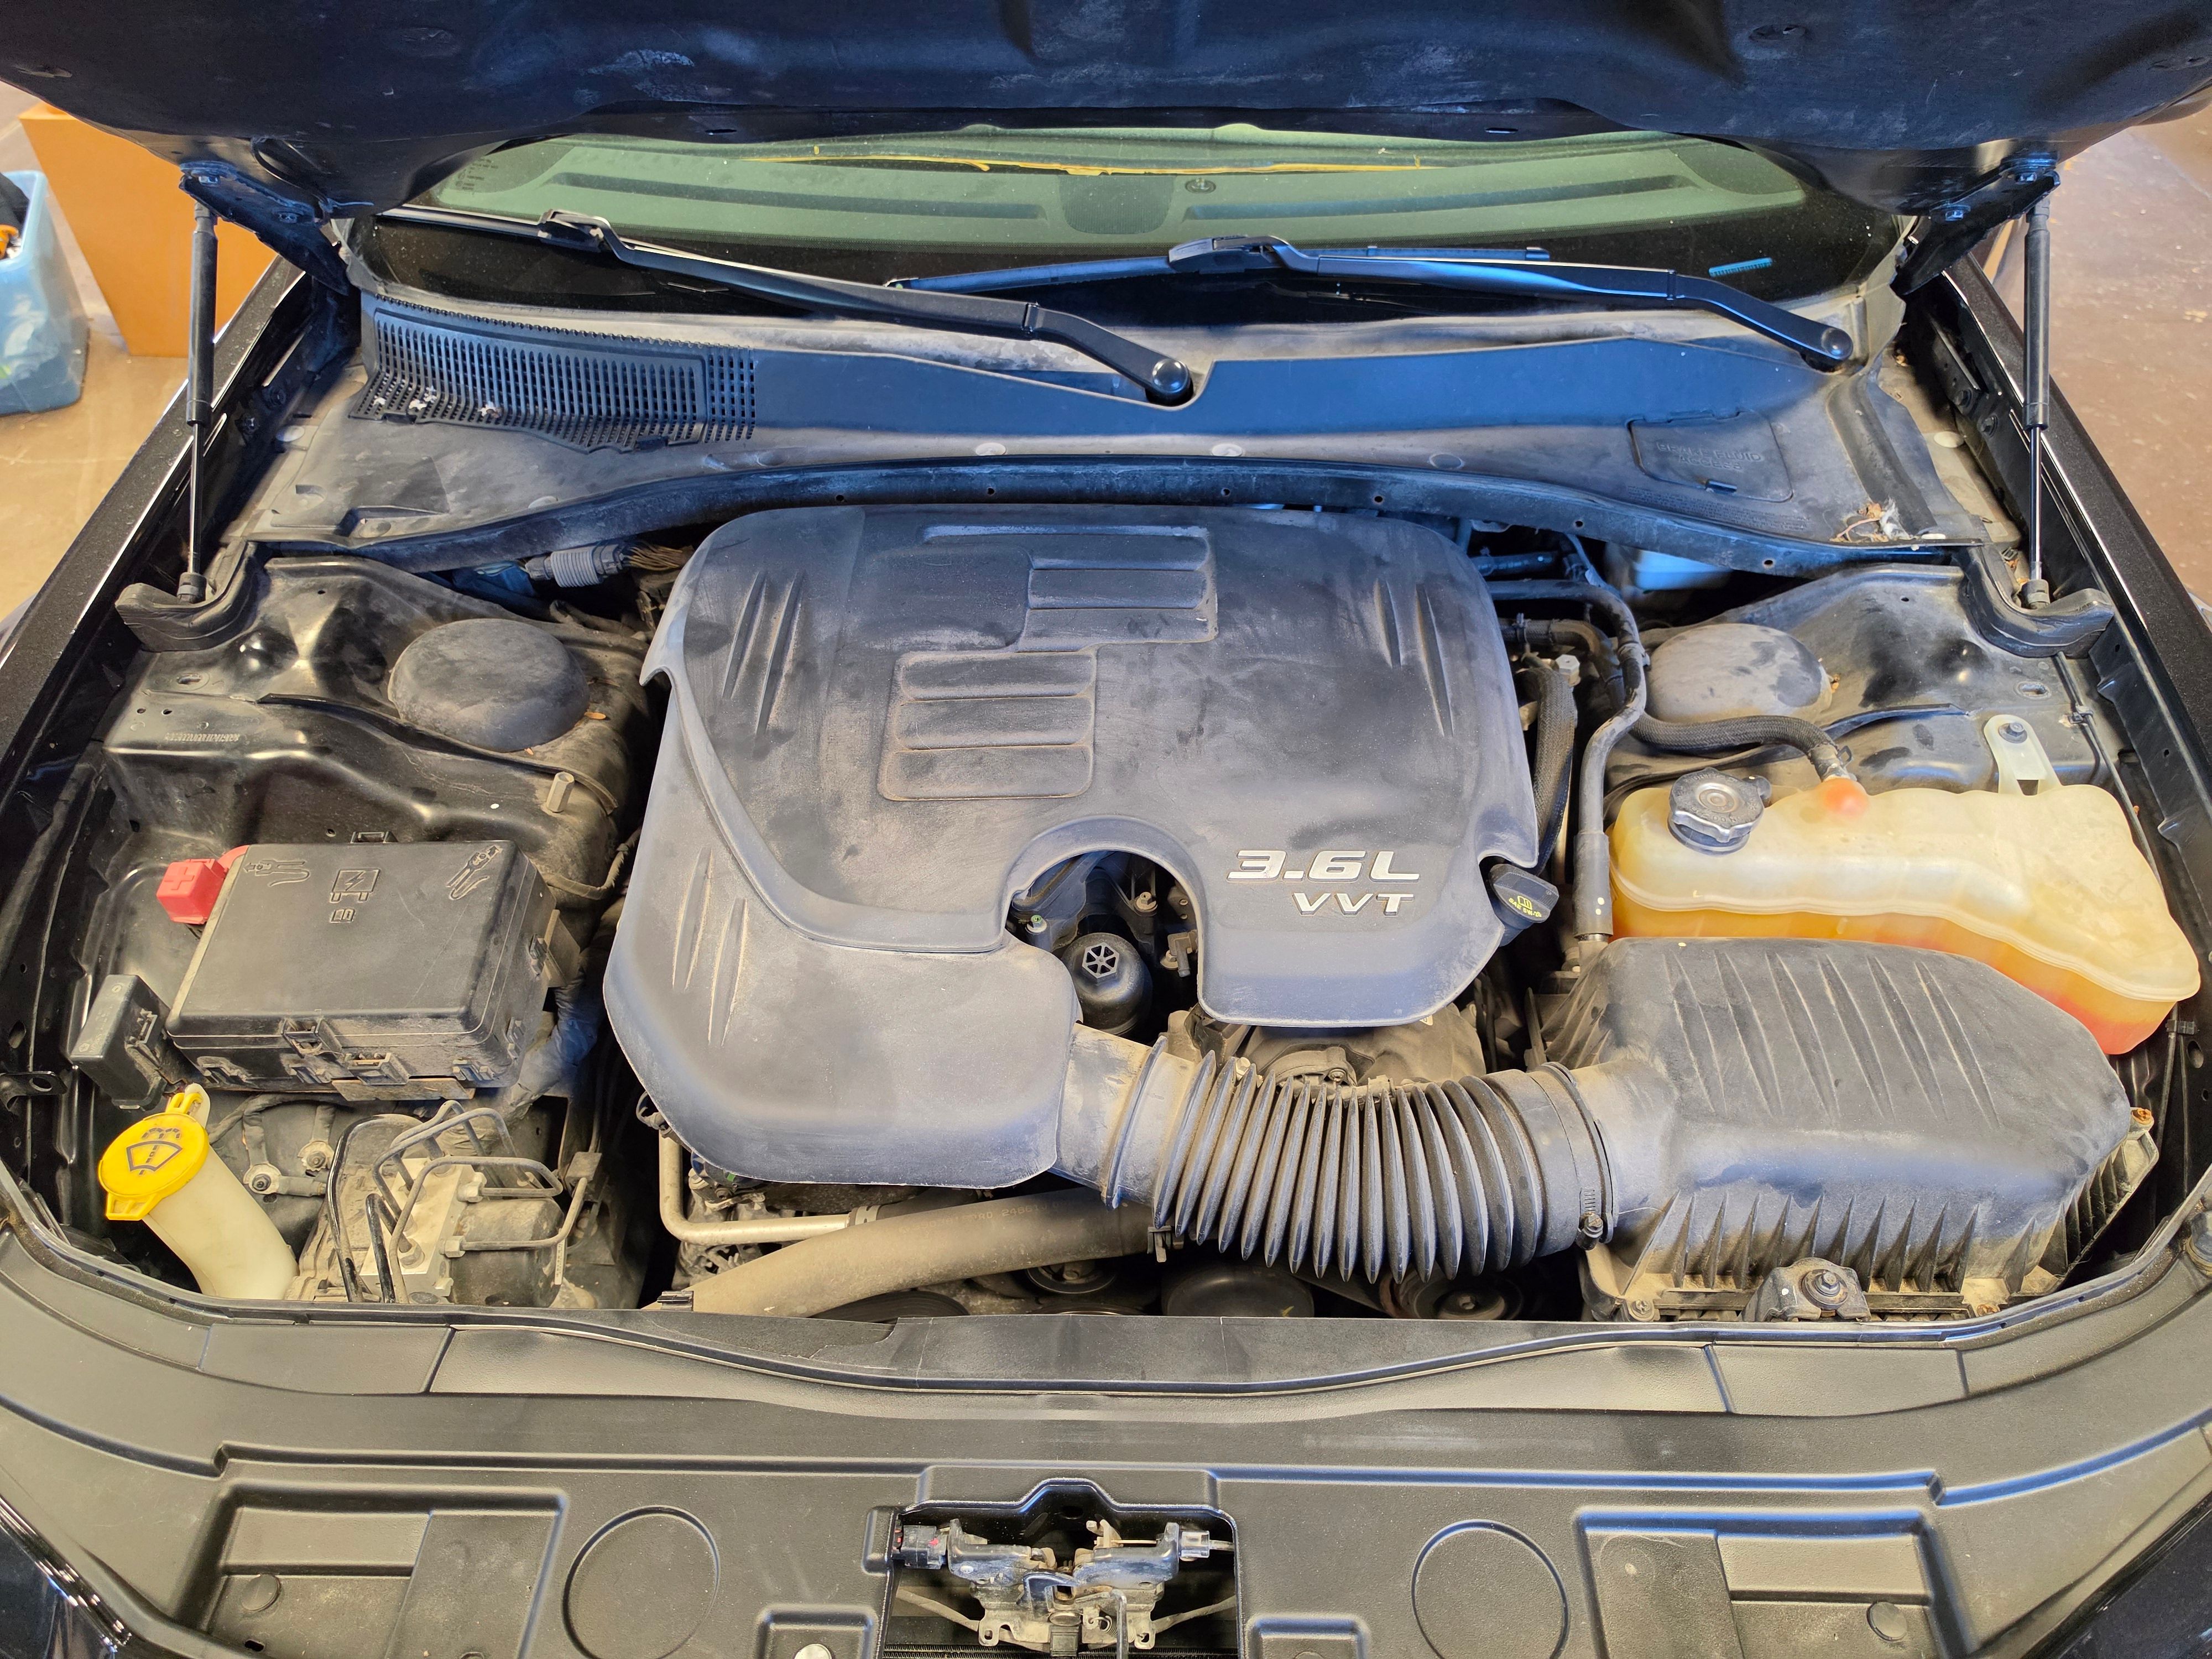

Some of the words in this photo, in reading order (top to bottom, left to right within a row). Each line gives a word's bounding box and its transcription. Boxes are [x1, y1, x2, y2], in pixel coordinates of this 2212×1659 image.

[1657, 442, 1709, 456] BRAKE
[1714, 450, 1762, 461] FLUID
[1679, 456, 1741, 469] ACCESS
[1226, 850, 1420, 882] 3.6L
[1292, 893, 1414, 916] VVT
[1509, 898, 1521, 910] SAE
